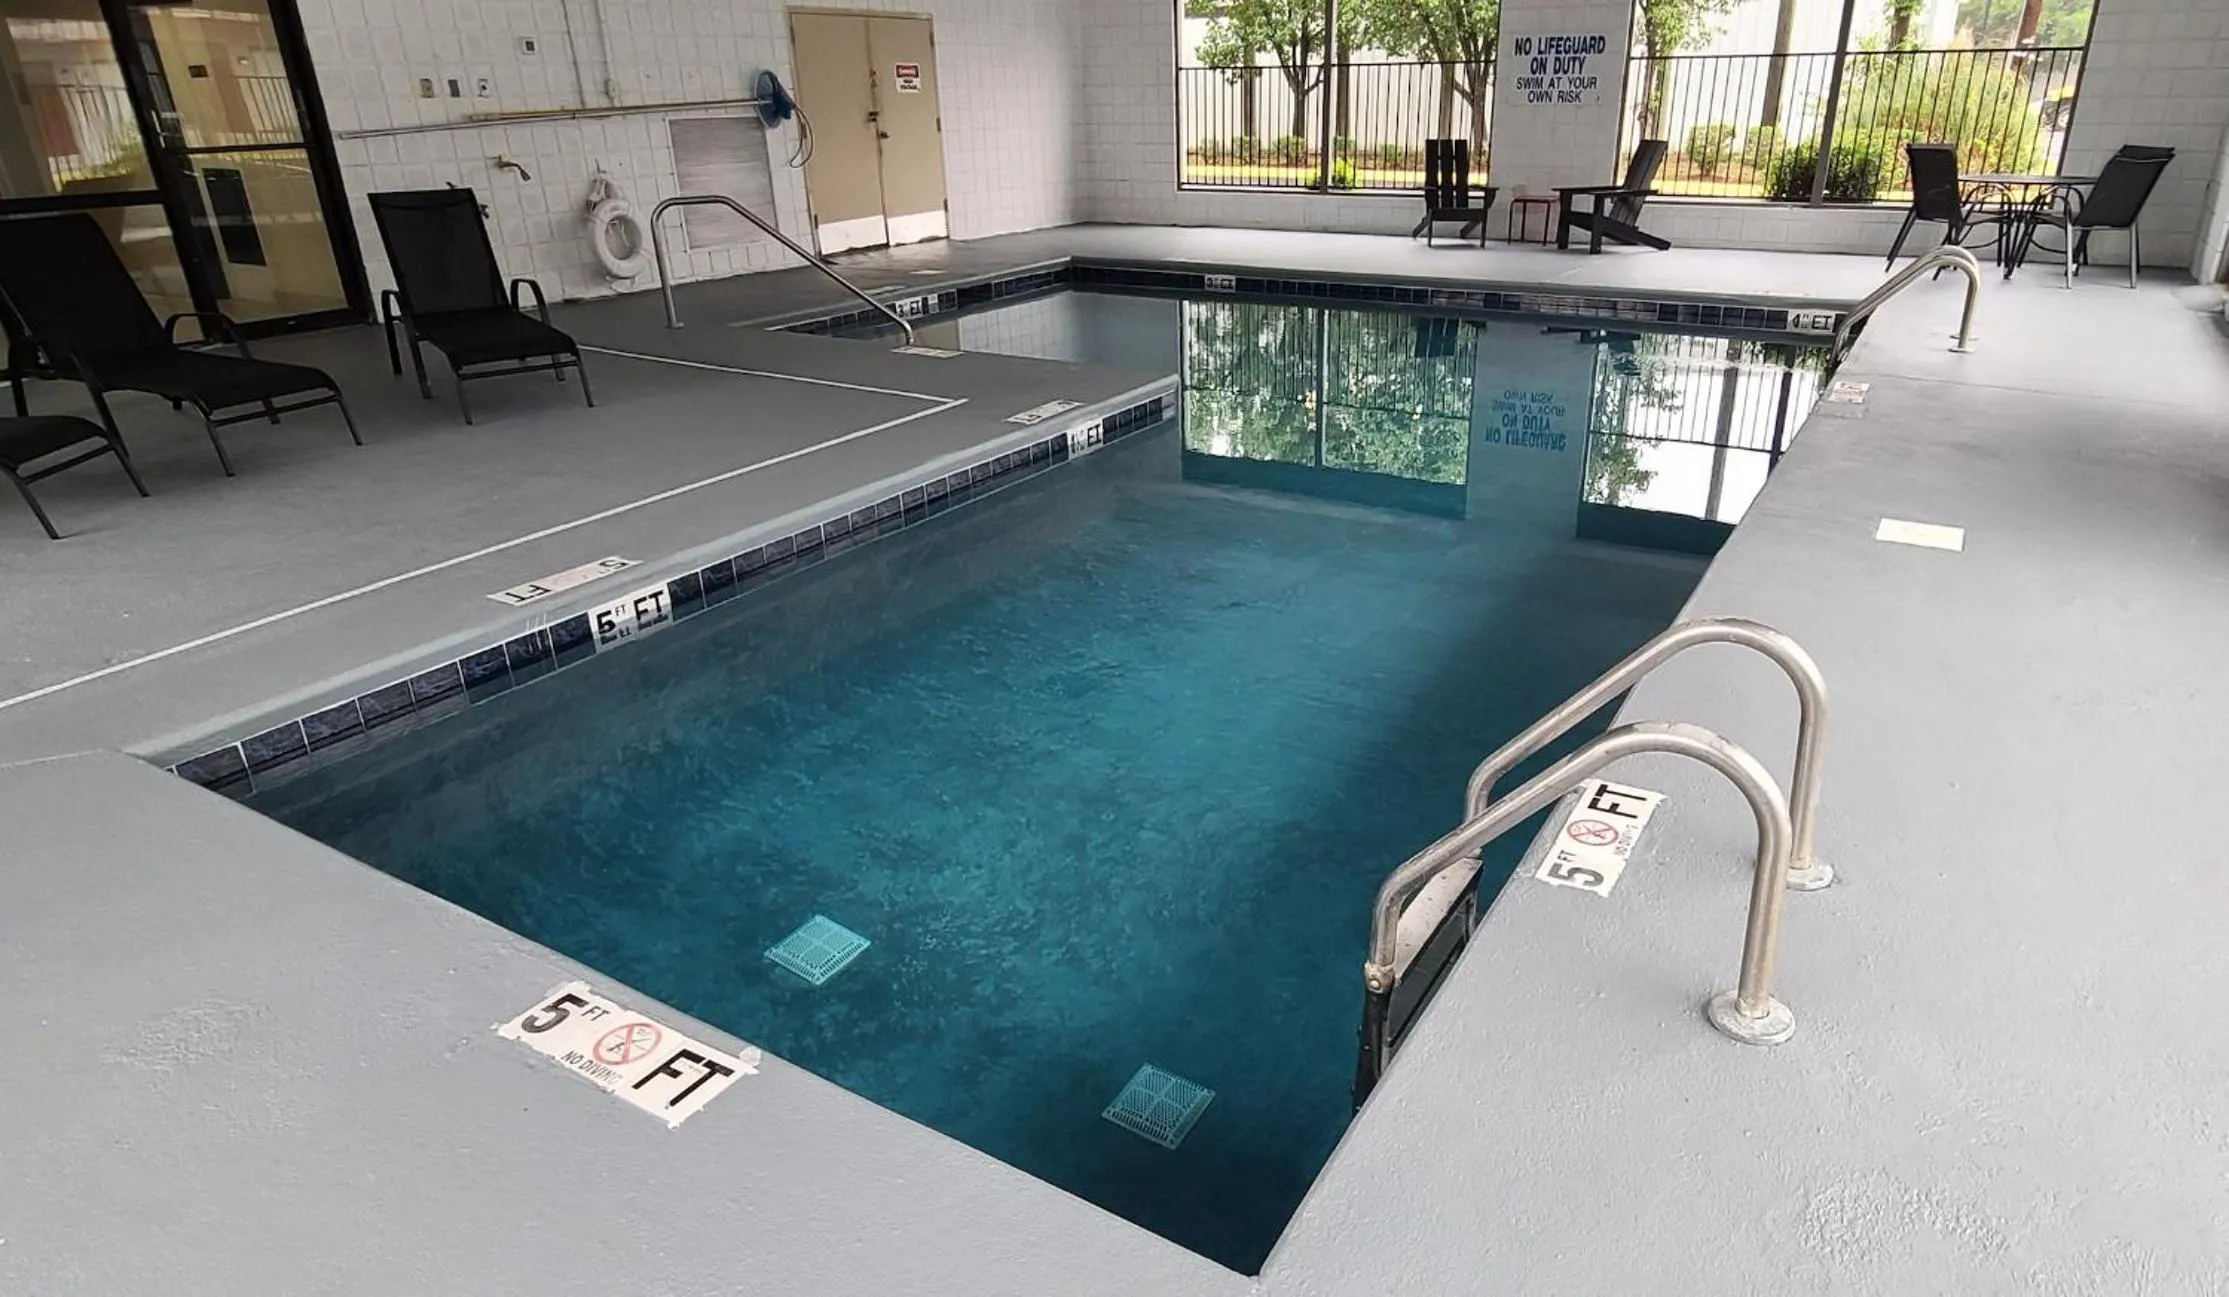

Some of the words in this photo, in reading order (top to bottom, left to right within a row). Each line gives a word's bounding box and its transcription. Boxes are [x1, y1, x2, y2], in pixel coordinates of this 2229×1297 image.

[1514, 37, 1532, 56] NO
[1537, 36, 1606, 55] LIFEGUARD
[1530, 57, 1547, 75] ON
[1553, 56, 1586, 75] DUTY
[1516, 77, 1543, 90] SWIM
[1548, 77, 1562, 89] AT
[1568, 77, 1597, 90] YOUR
[1527, 90, 1552, 103] OWN
[1557, 90, 1582, 103] RISK
[505, 583, 552, 603] FT
[596, 610, 616, 635] 5
[615, 604, 626, 616] FT
[634, 590, 664, 621] FT
[1587, 784, 1648, 819] FT
[1557, 849, 1577, 862] FT
[1547, 862, 1604, 887] 5
[521, 993, 589, 1034] 5
[580, 1004, 611, 1022] FT
[631, 1048, 736, 1107] FT
[560, 1050, 584, 1065] NO
